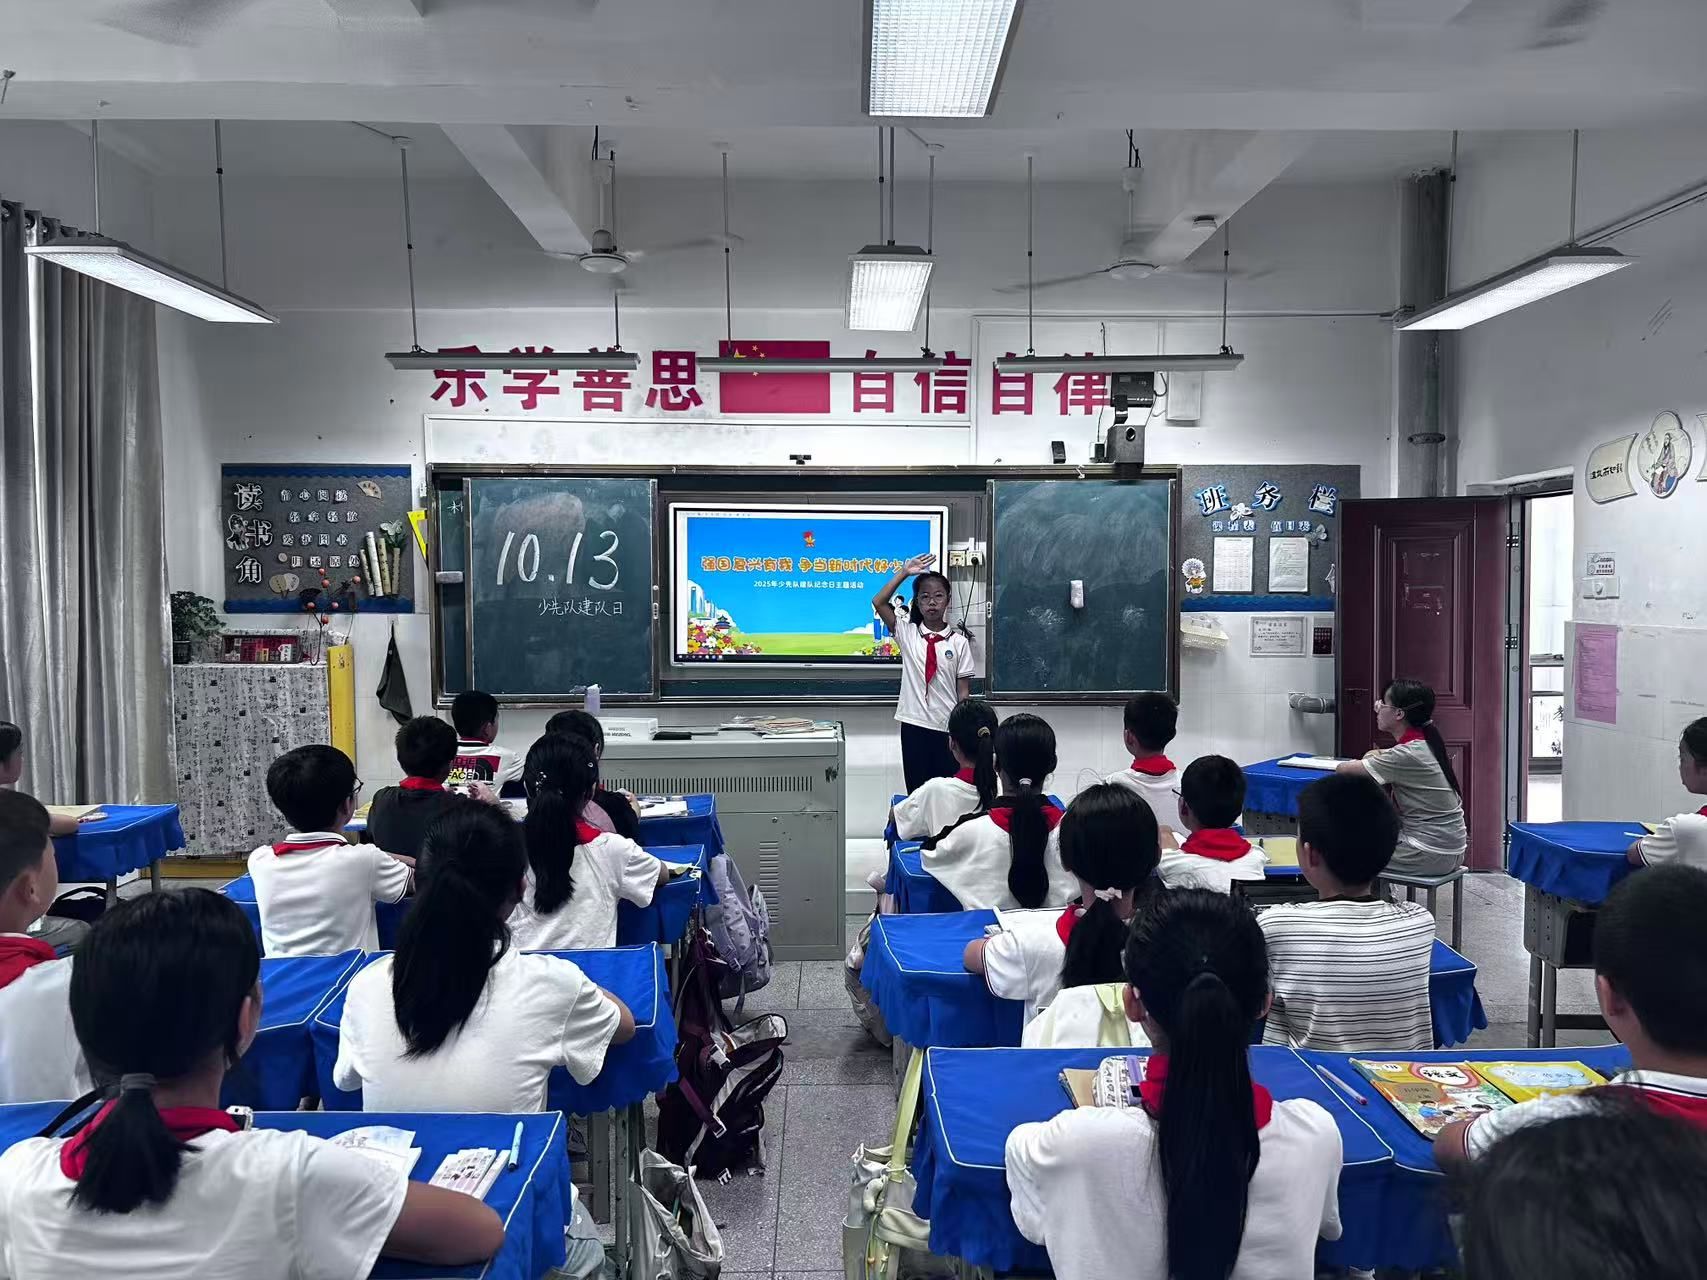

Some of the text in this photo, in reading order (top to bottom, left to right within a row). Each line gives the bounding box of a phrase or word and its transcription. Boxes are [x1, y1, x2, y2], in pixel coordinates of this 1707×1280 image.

[431, 346, 702, 411] 乐学善思
[1197, 481, 1337, 516] 班务栏
[497, 530, 619, 590] 10.13
[701, 556, 911, 574] 强国复兴有我 争当新时代好少
[754, 580, 864, 589] 2025年少先队建队纪念日主题活动
[538, 597, 623, 616] 少先队建队日
